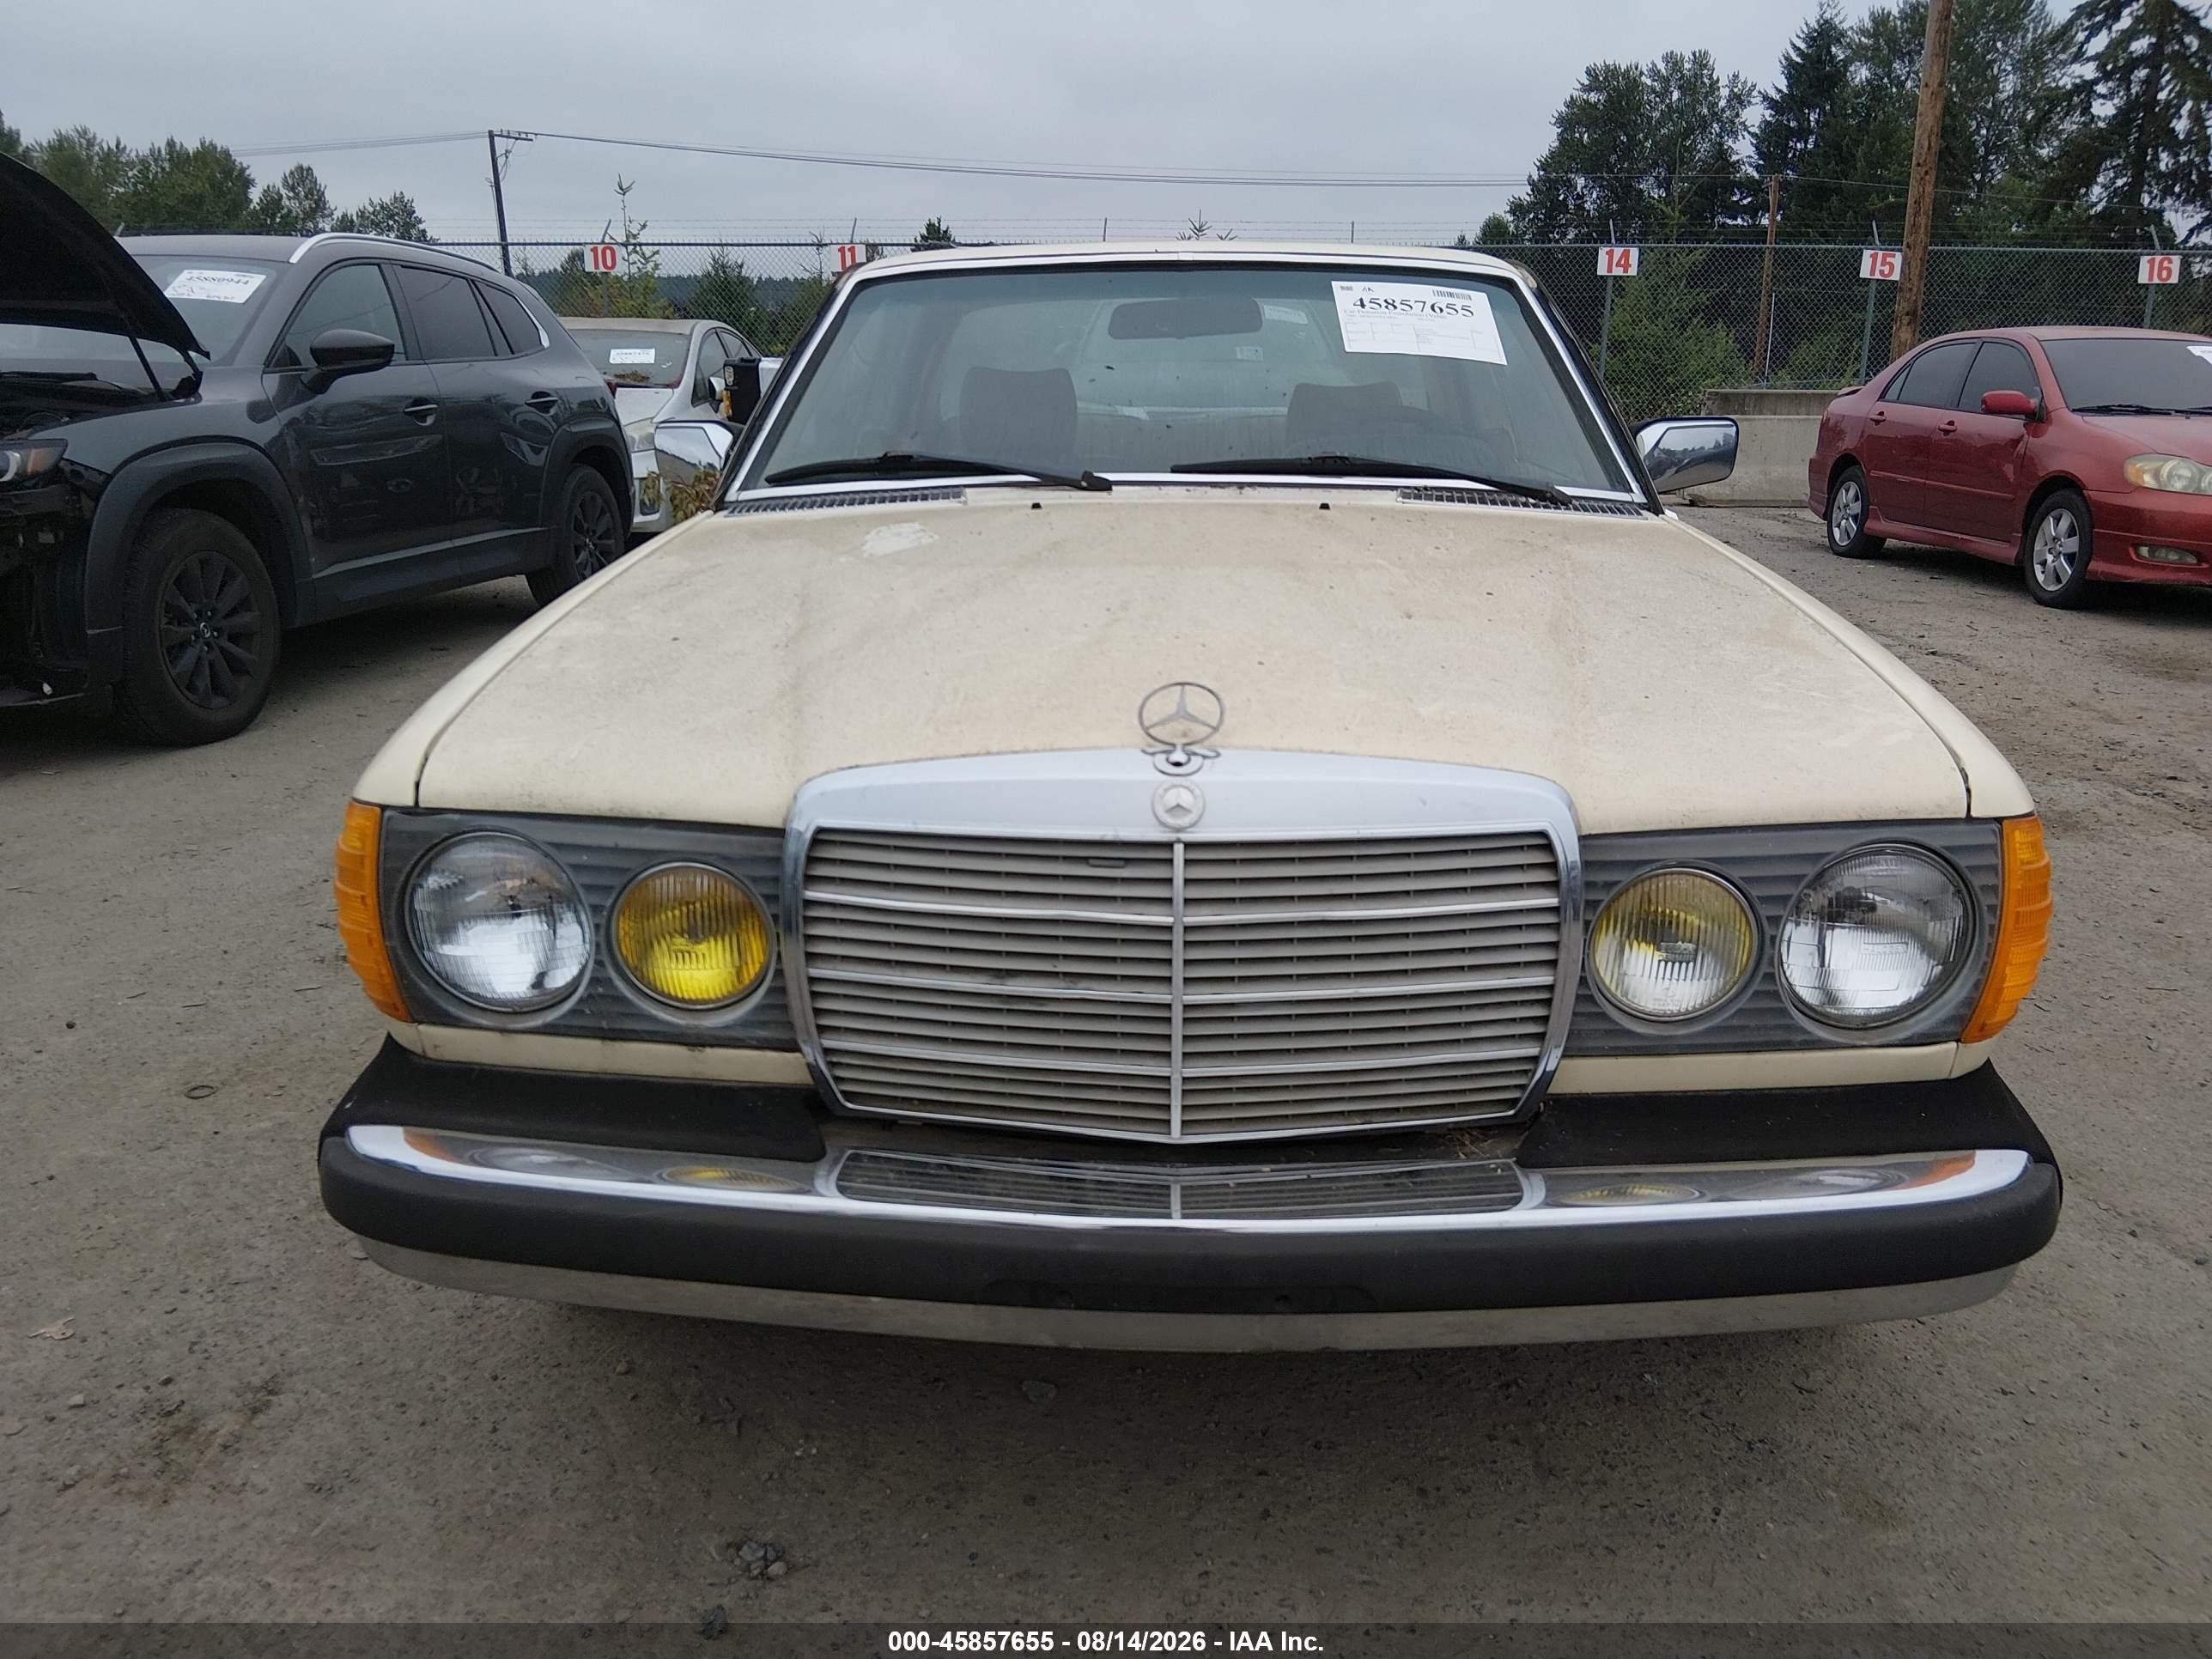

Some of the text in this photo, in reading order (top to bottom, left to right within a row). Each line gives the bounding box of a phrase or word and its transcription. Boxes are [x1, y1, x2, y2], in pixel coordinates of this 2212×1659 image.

[591, 246, 617, 270] 10
[837, 246, 856, 270] 11
[1605, 249, 1632, 274] 14
[1868, 252, 1896, 277] 15
[2146, 256, 2174, 283] 16
[1352, 296, 1474, 318] 45857655
